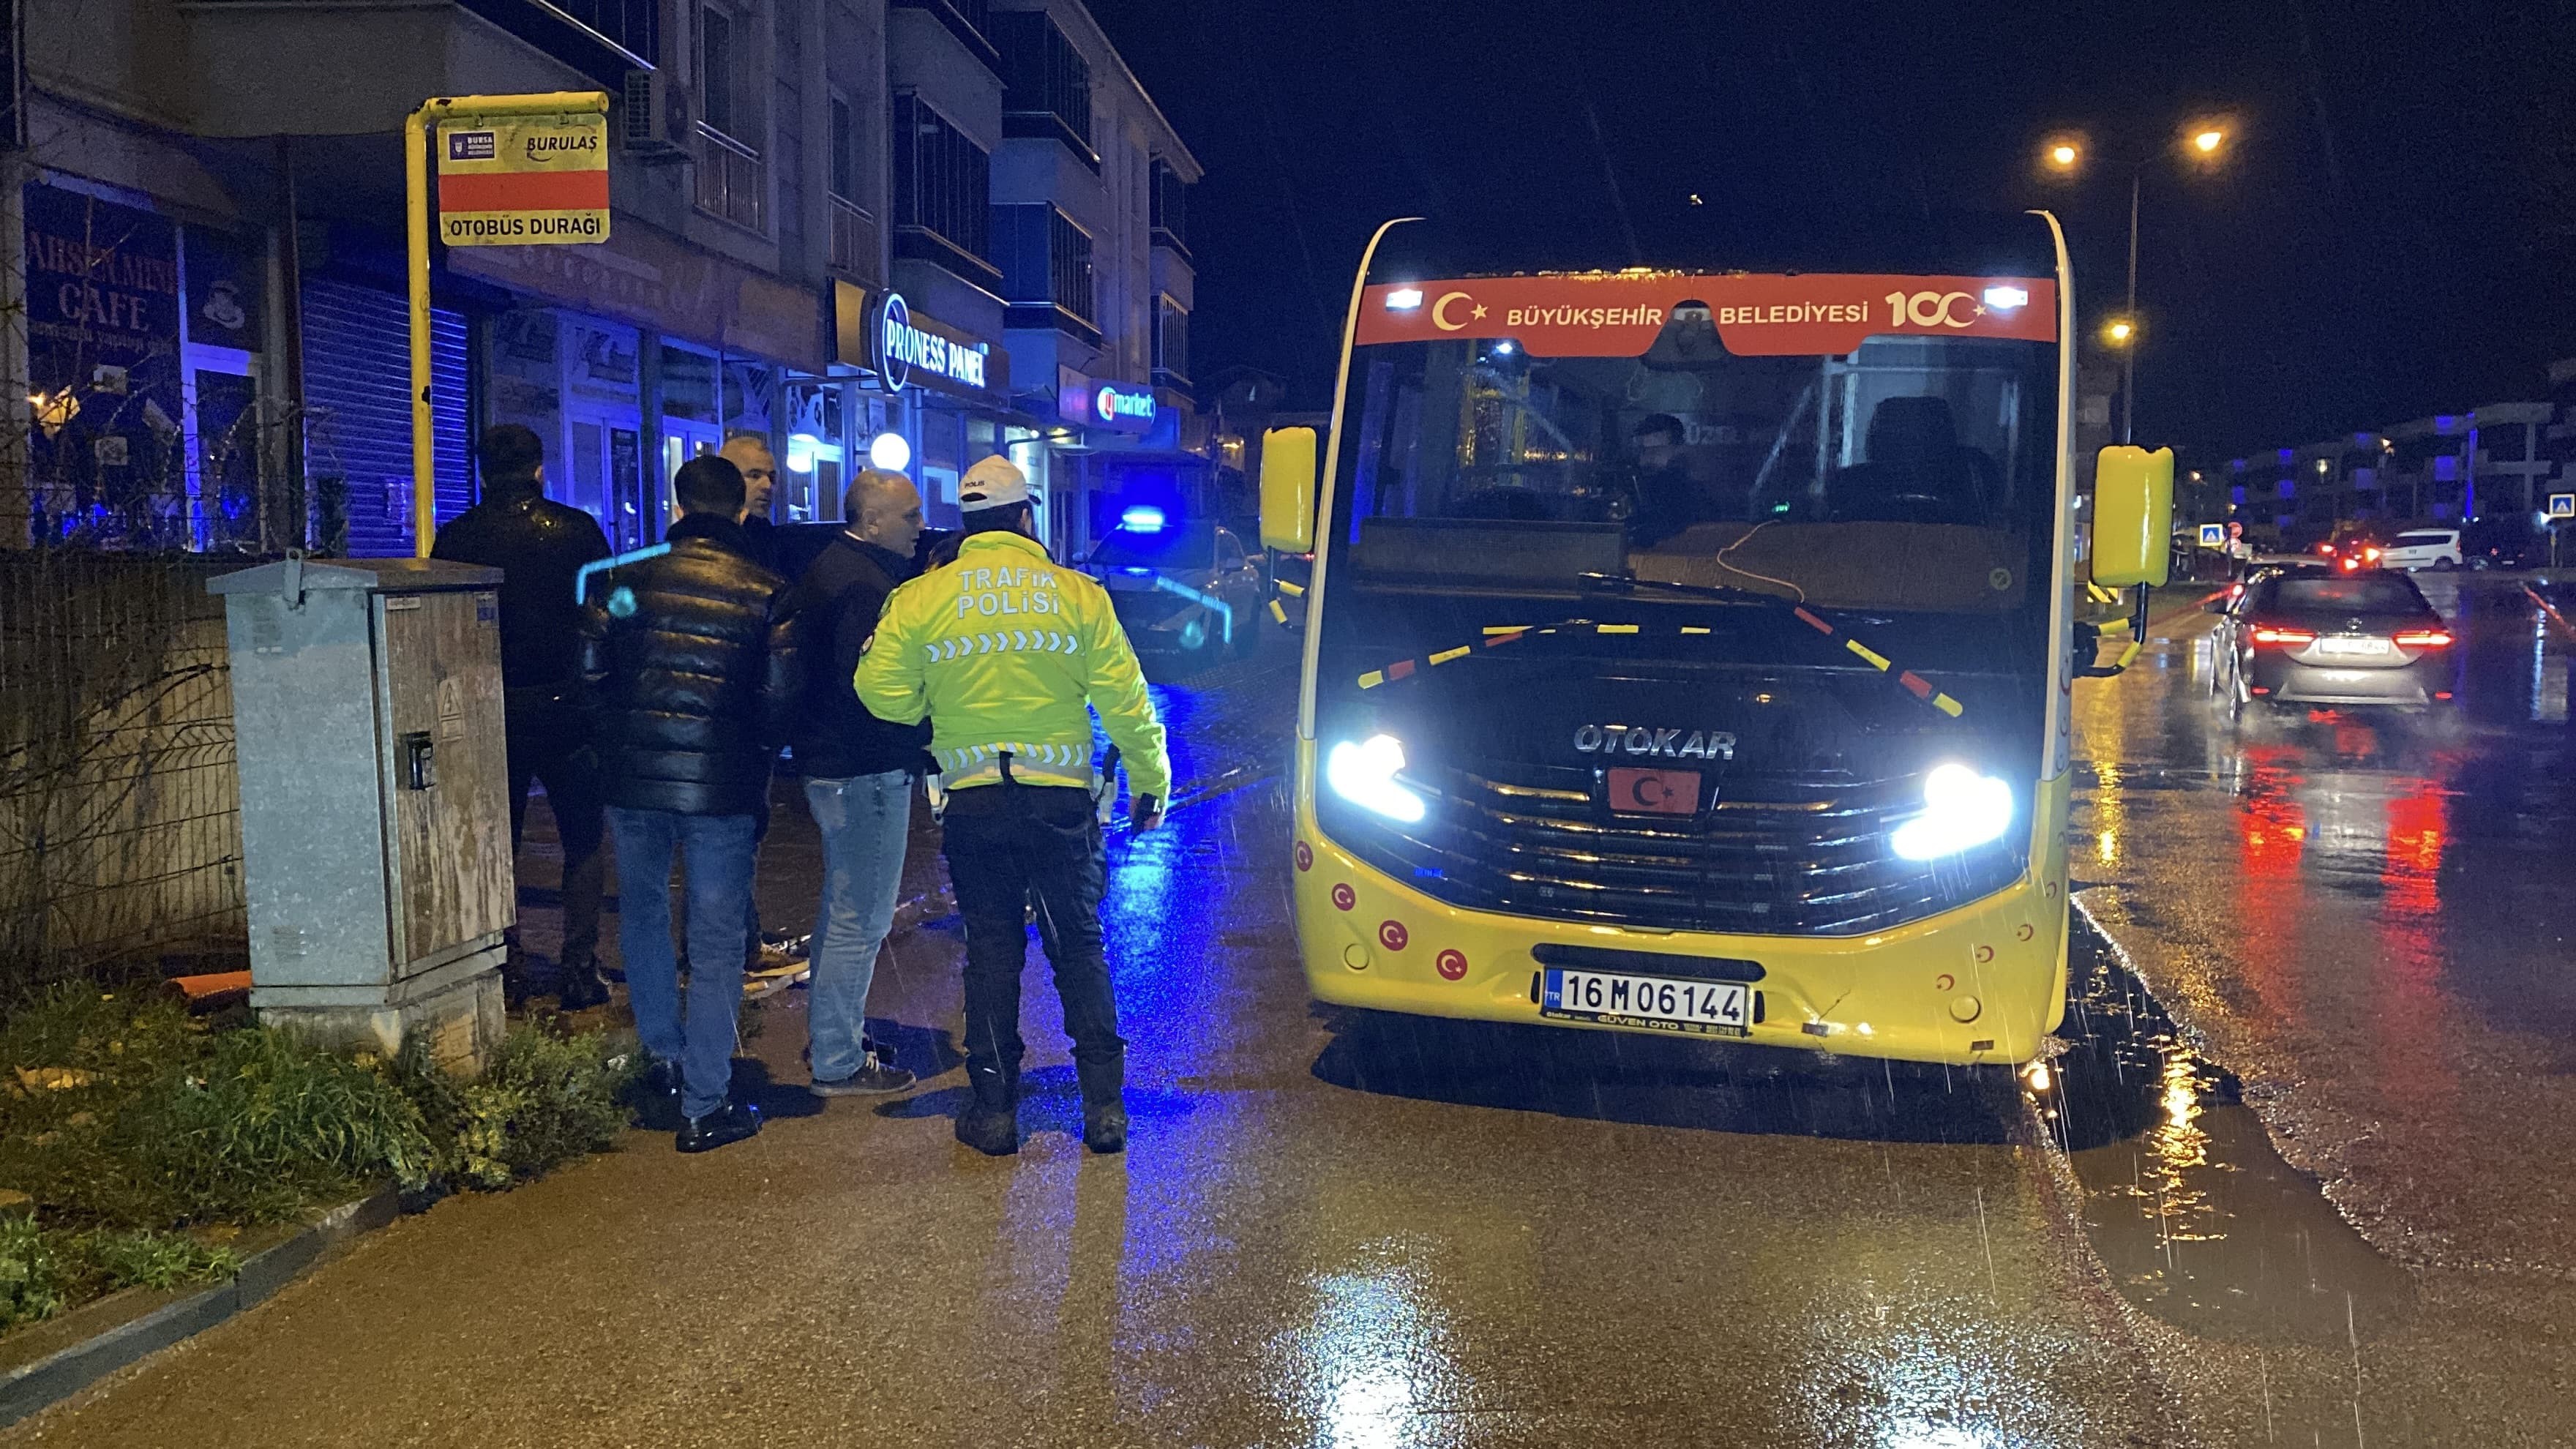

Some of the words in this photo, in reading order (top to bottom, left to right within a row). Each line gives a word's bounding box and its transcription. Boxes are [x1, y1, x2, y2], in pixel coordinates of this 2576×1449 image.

[468, 136, 493, 144] BURSA
[527, 135, 597, 152] BURULAŞ
[451, 214, 523, 236] OTOBÜS
[531, 213, 600, 235] DURAĞI
[1507, 304, 1663, 329] BÜYÜKŞEHİR
[1720, 301, 1868, 324] BELEDİYESİ
[886, 318, 946, 373] PRONESS
[948, 342, 985, 388] PANEL
[1574, 724, 1737, 760] OTOKAR
[1549, 991, 1560, 1001] TR
[1649, 1020, 1679, 1030] OTO
